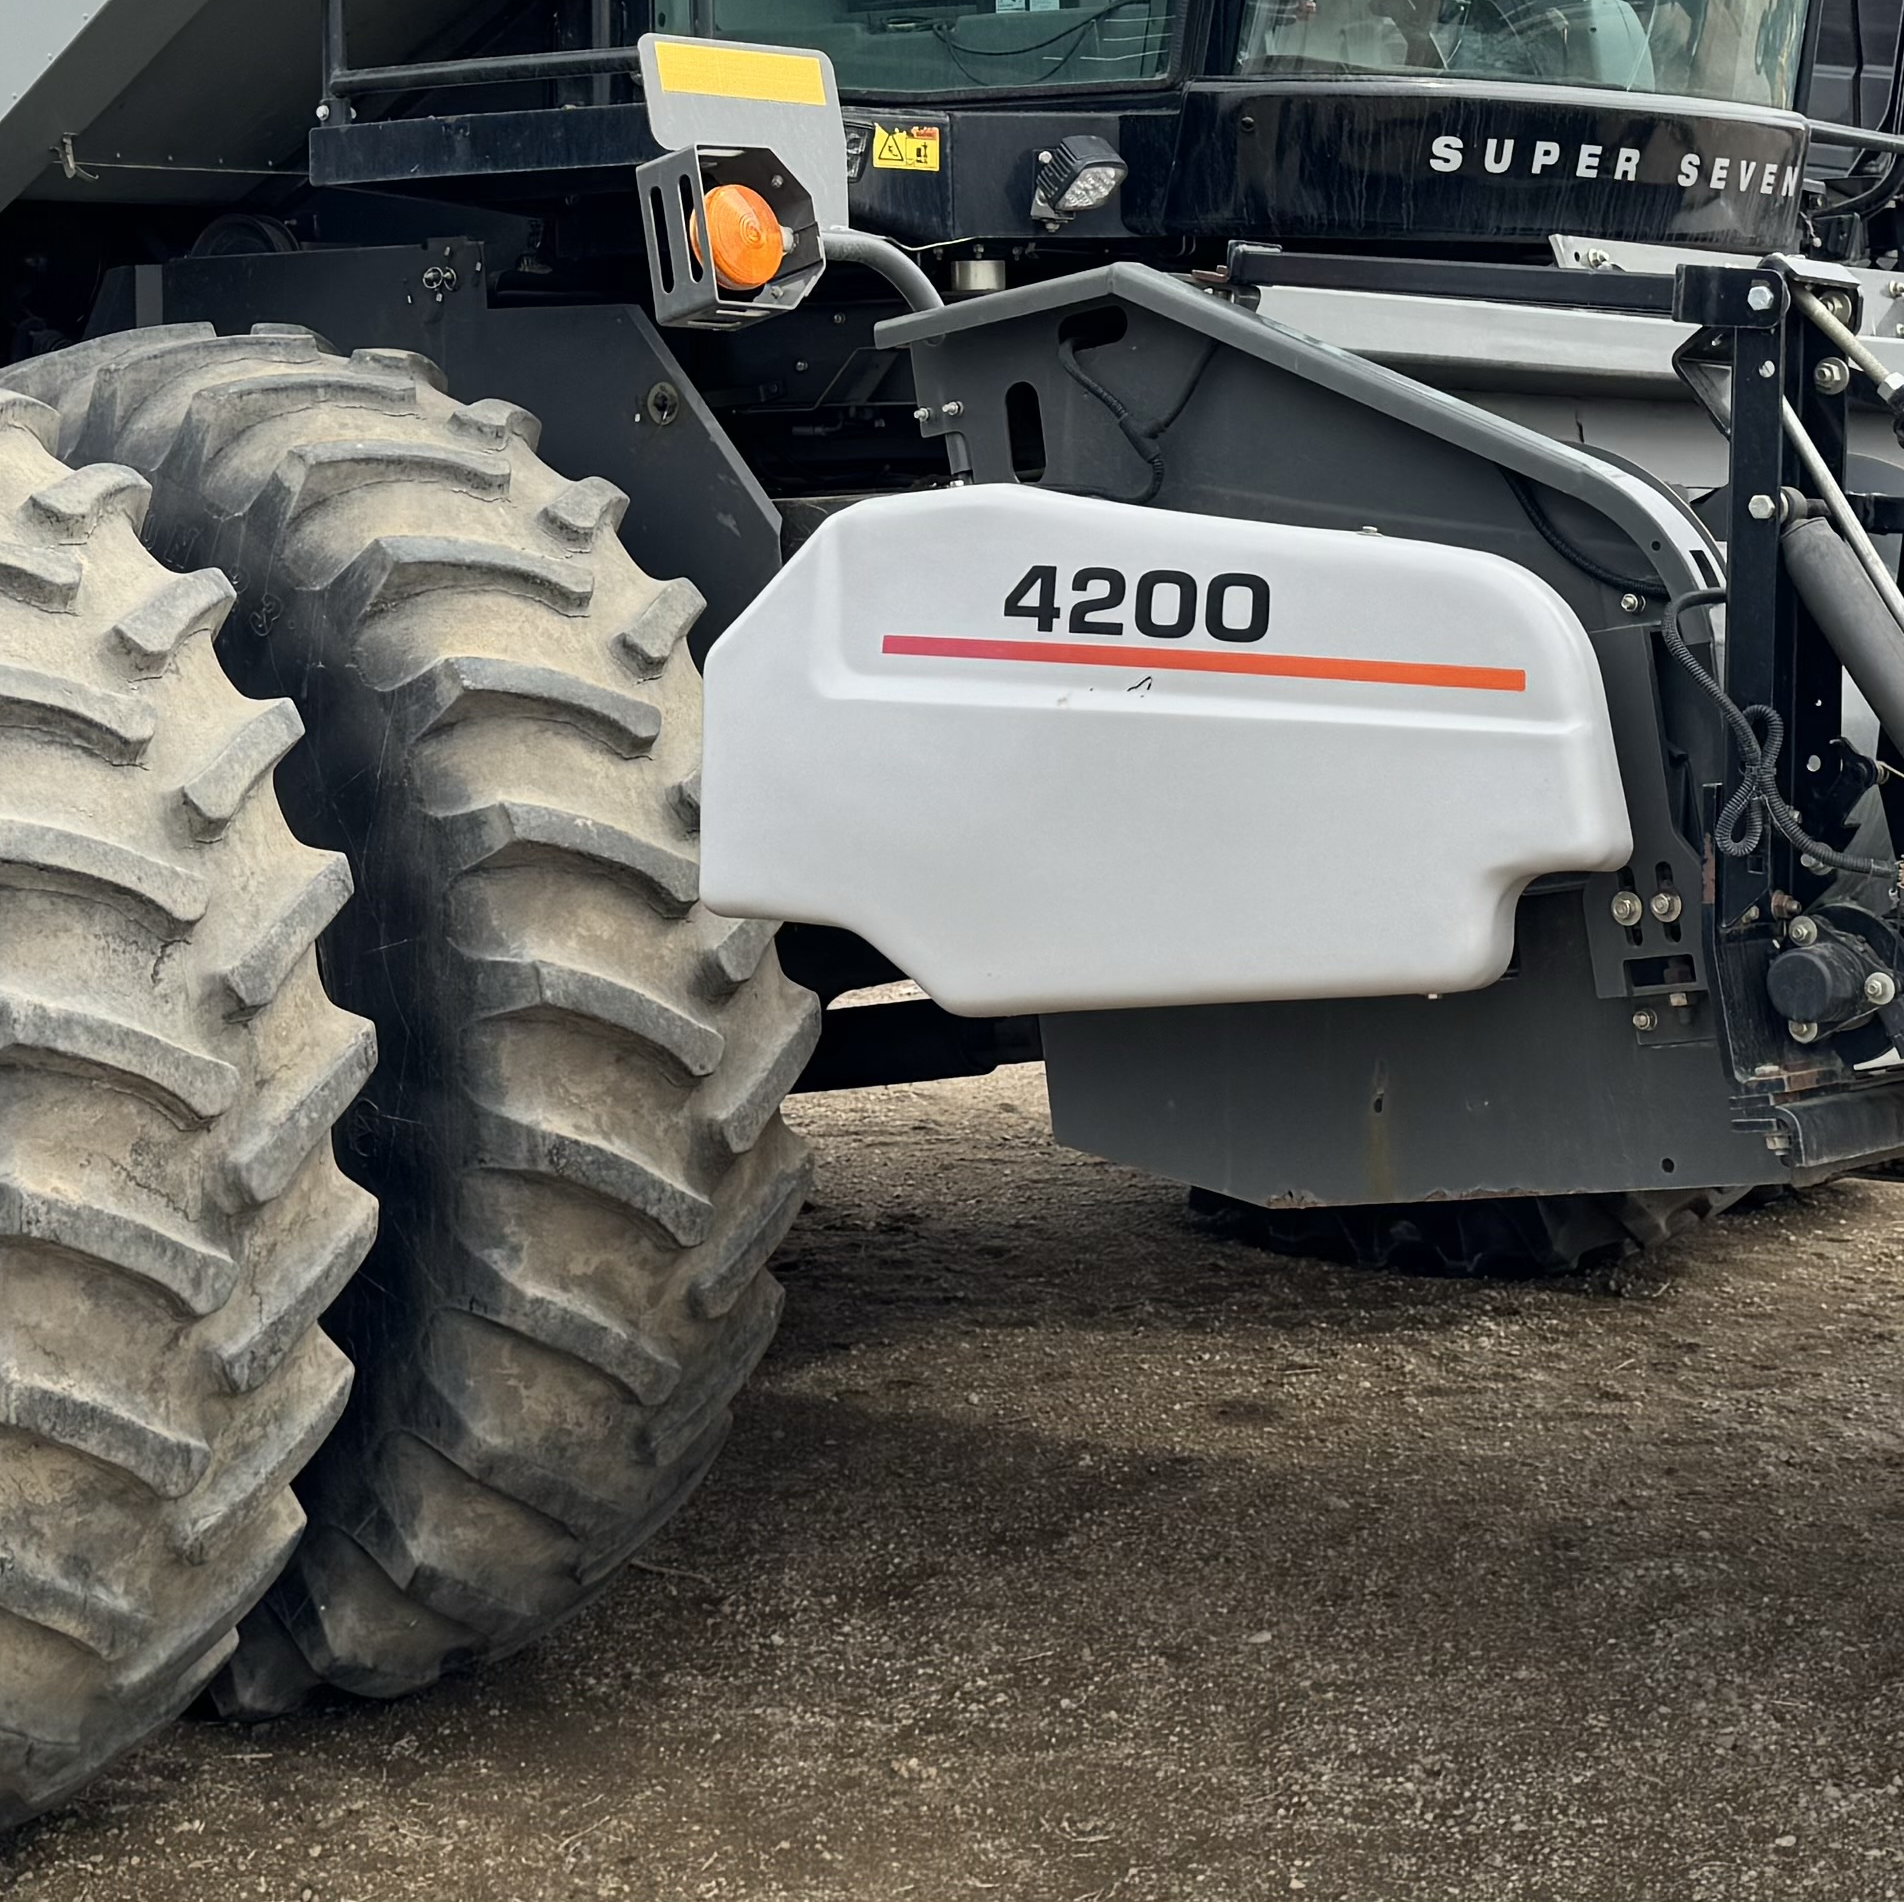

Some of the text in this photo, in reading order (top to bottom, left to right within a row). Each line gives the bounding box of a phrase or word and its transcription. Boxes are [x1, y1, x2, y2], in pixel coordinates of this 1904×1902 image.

[1429, 134, 1799, 197] SUPER SEVEN
[1004, 565, 1270, 643] 4200
